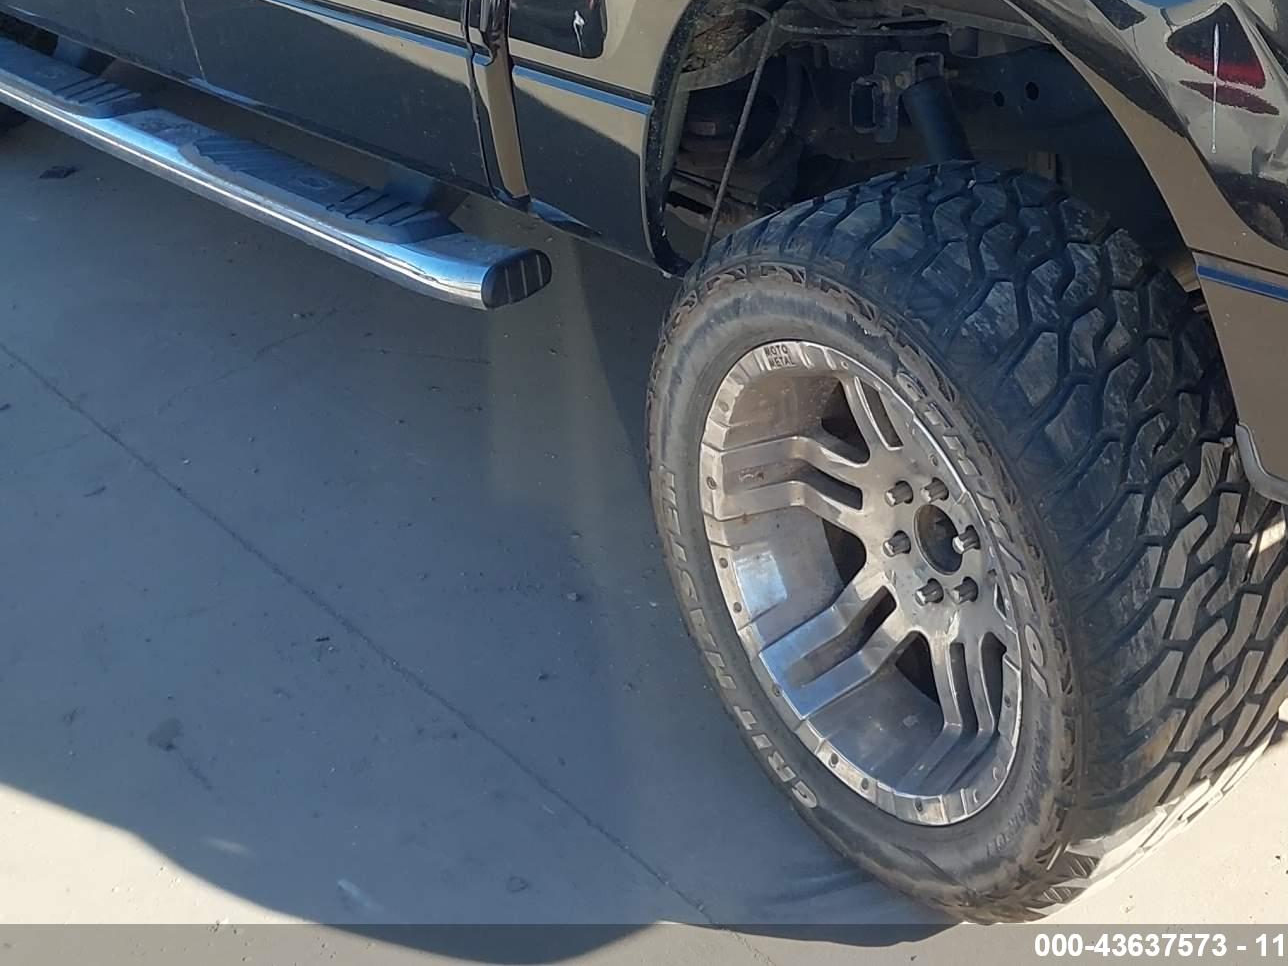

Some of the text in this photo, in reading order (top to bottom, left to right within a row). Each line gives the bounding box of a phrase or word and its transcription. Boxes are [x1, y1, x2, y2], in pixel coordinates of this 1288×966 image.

[763, 344, 788, 355] MOTO
[767, 355, 796, 367] METAL
[733, 705, 818, 809] GRIT
